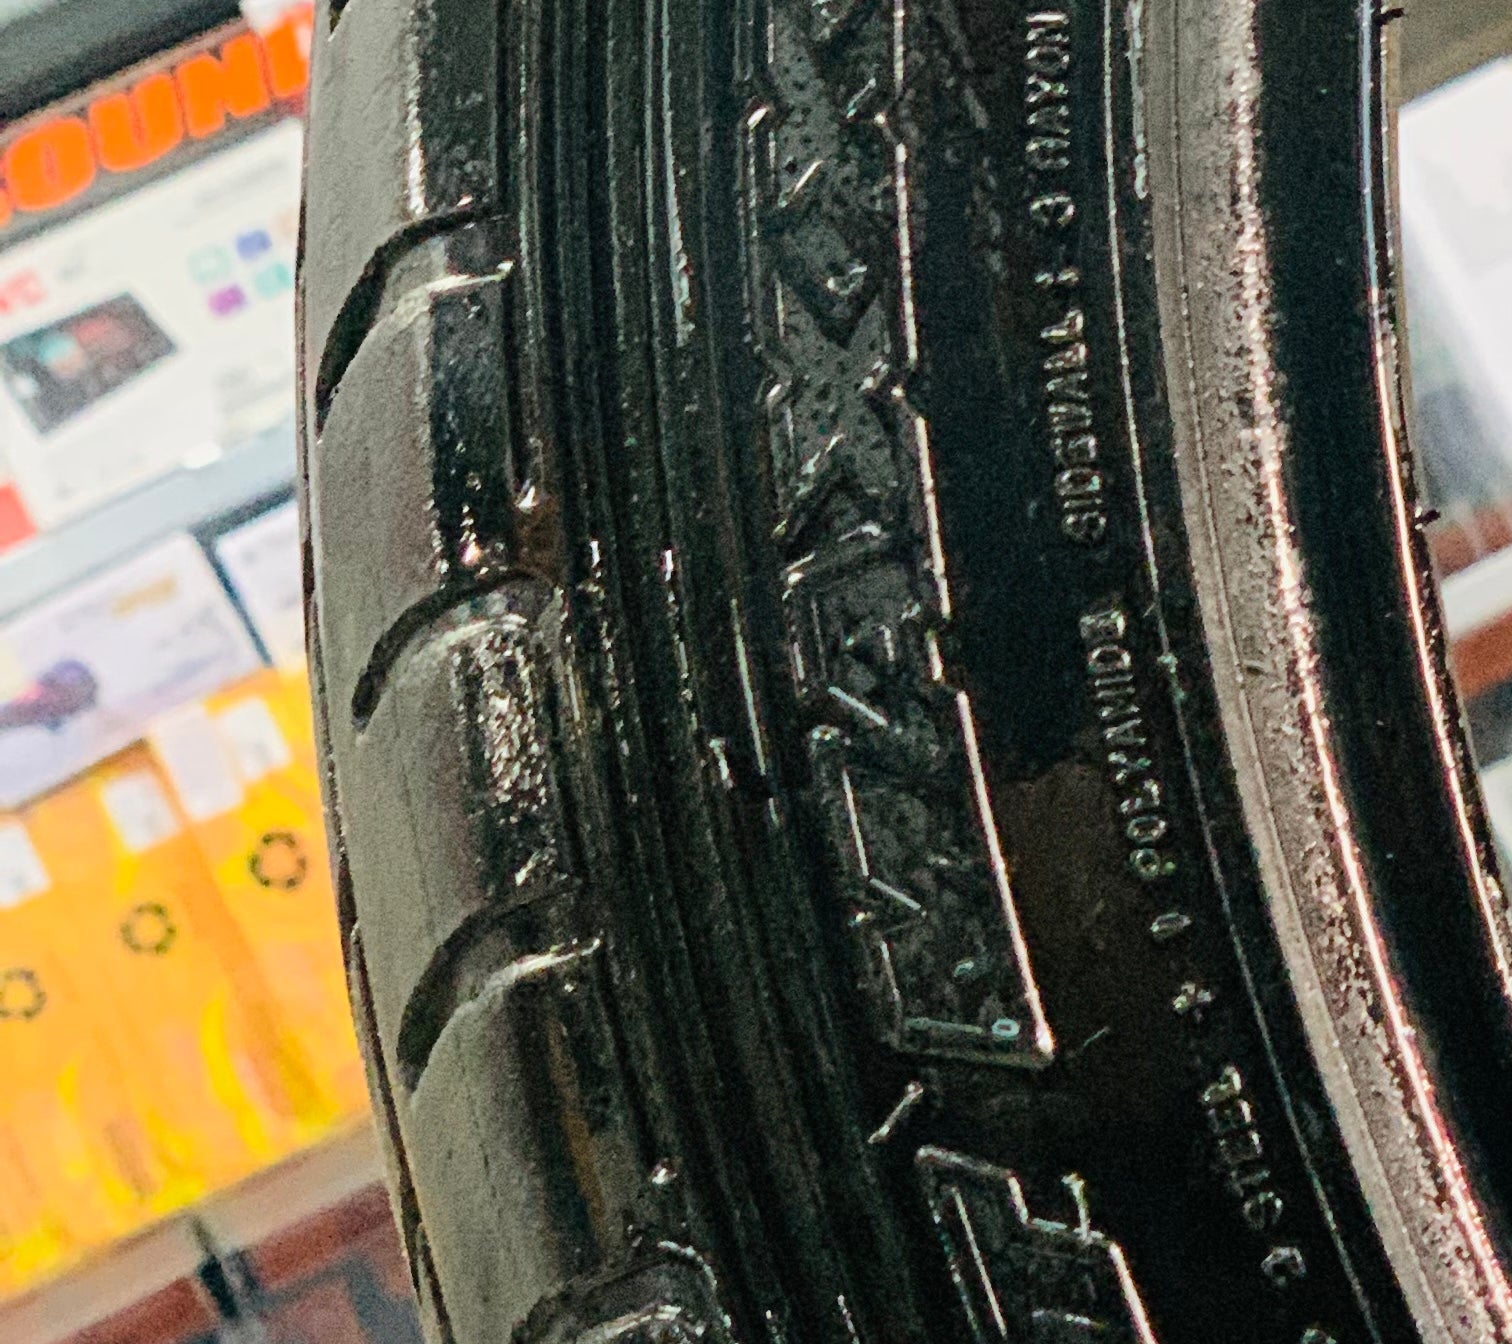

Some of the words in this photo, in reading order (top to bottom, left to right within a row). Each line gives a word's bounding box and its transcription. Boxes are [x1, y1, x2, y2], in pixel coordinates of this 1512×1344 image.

[0, 14, 313, 226] OUN
[1022, 7, 1073, 171] RAYON
[1077, 598, 1180, 882] POLYAMIDE
[1198, 1059, 1285, 1234] STEEL
